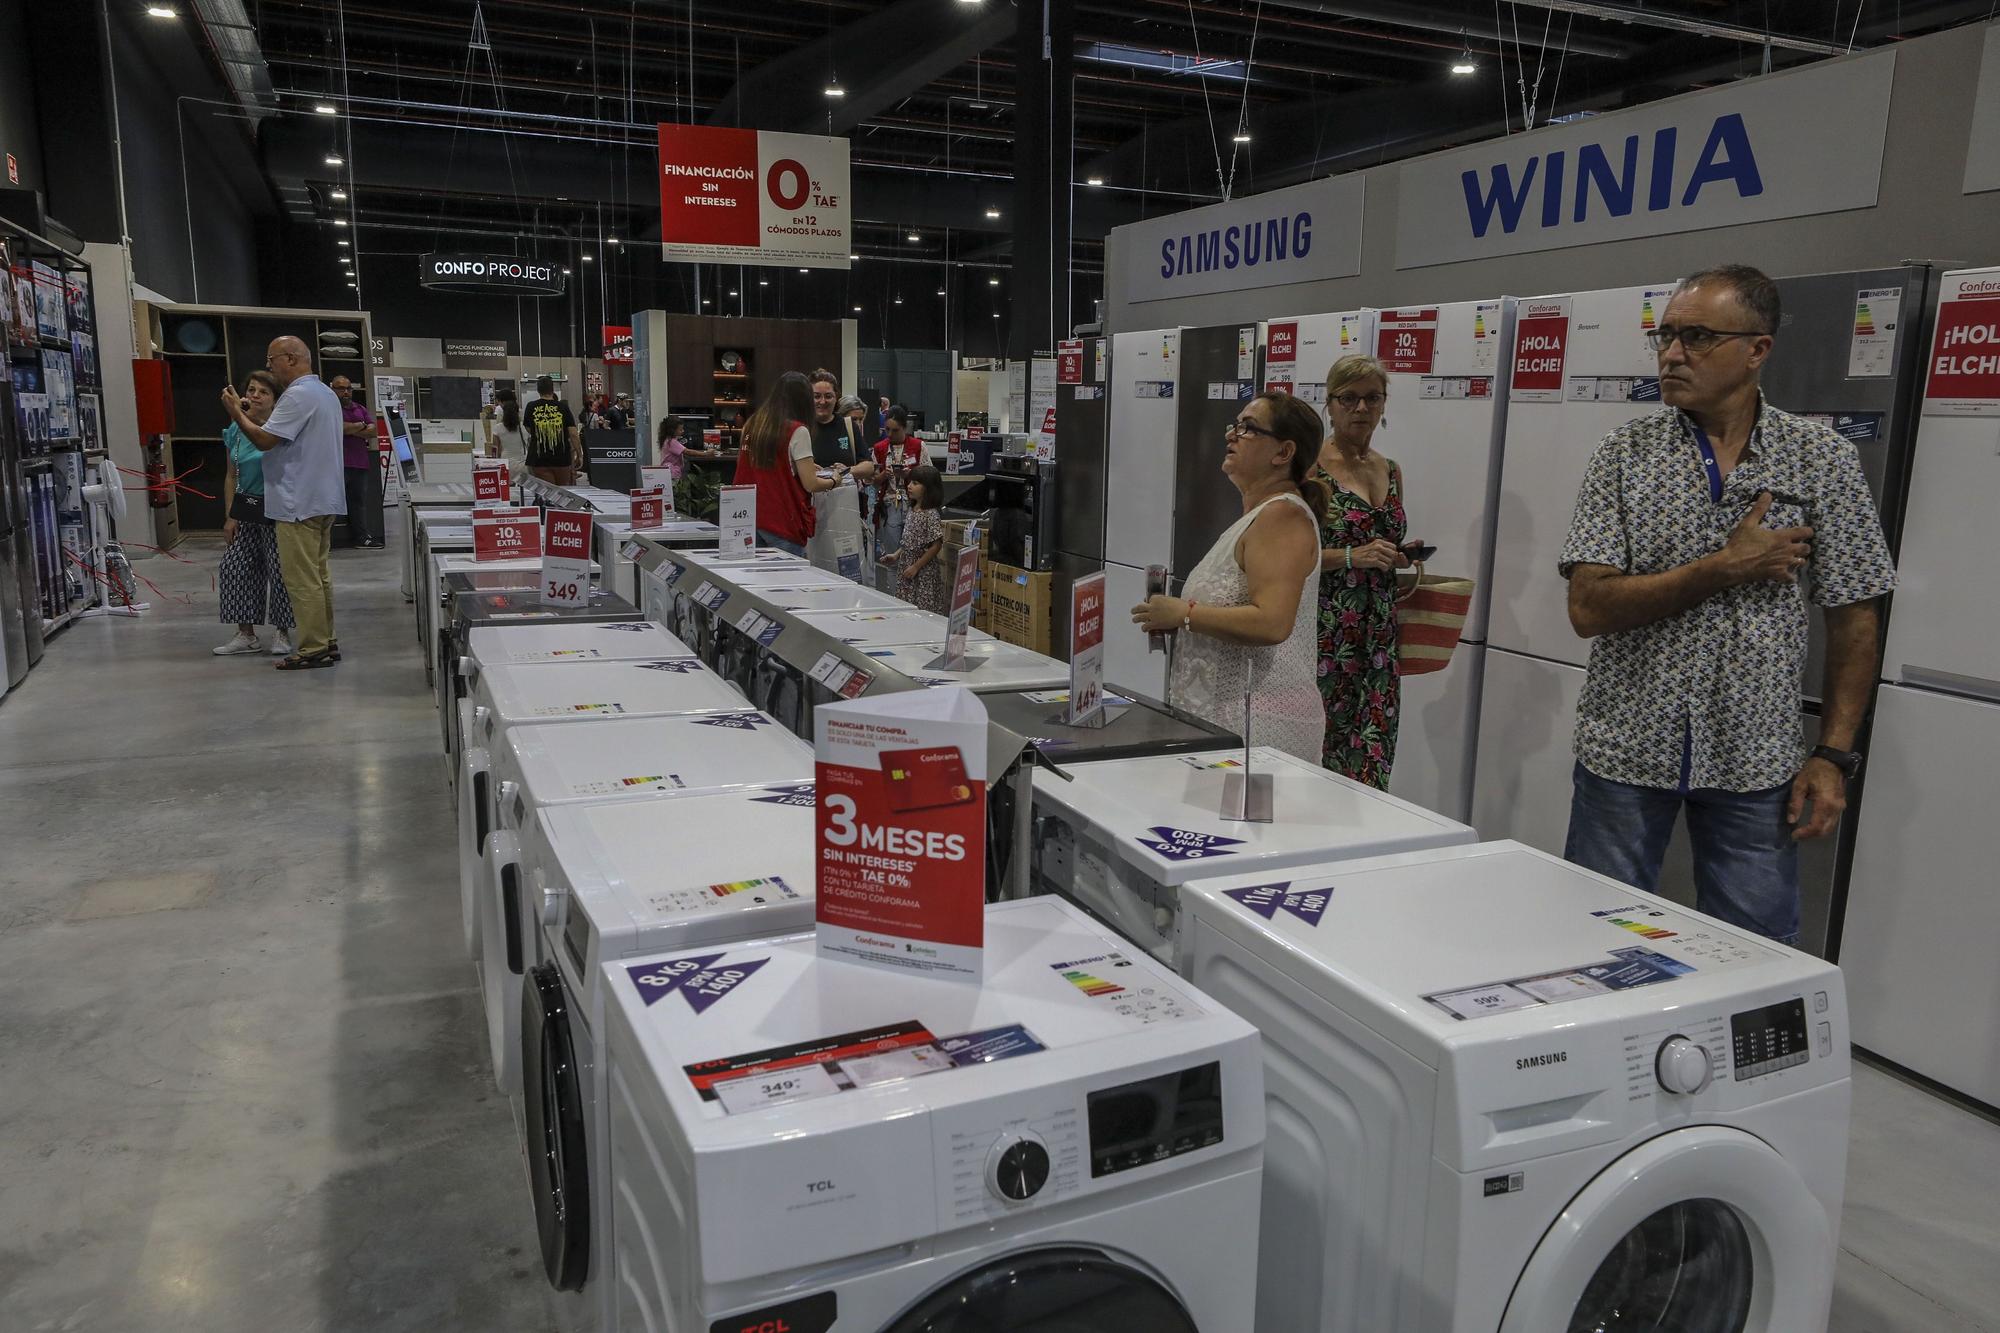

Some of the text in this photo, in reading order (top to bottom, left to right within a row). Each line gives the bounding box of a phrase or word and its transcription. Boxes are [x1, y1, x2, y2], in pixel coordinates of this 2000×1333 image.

[664, 164, 754, 180] FINANCIACIÓN
[1461, 113, 1763, 238] WINIA
[702, 183, 719, 192] SIN
[684, 196, 737, 207] INTERESES
[793, 215, 817, 225] EN 12
[767, 224, 842, 237] CÓMODOS PLAZOS
[1161, 212, 1312, 279] SAMSUNG
[434, 261, 551, 281] CONFO PROJECT
[1528, 304, 1561, 314] Conforama
[1272, 332, 1291, 343] ¡HOLA
[1521, 336, 1561, 353] ¡HOLA
[1271, 344, 1292, 354] ELCHE!
[1395, 348, 1416, 357] EXTRA
[1516, 357, 1561, 372] ELCHE!
[1935, 355, 2000, 375] ELCH
[606, 450, 633, 458] CONFO
[478, 478, 495, 486] ¡HOLA
[479, 487, 497, 495] ELCHE!
[554, 522, 581, 533] ¡HOLA
[496, 539, 523, 547] EXTRA
[552, 536, 582, 548] ELCHE!
[1080, 596, 1099, 616] ¡HOLA
[1079, 617, 1100, 637] ELCHE!
[827, 720, 907, 736] FINANCIAR TU COMPRA
[920, 753, 959, 763] Conforama
[824, 793, 966, 861] 3 MESES
[1171, 830, 1216, 843] 1200
[1175, 838, 1204, 847] RPM
[823, 848, 843, 862] SIN
[1155, 843, 1204, 858] 9 Kg
[860, 868, 885, 883] TAE
[824, 876, 885, 894] CON TU TARJETA
[823, 885, 920, 909] DE CRÉDITO CONFORAMA
[1300, 894, 1326, 912] 1400
[855, 935, 896, 949] Conforama
[638, 960, 701, 987] 8 Kg
[684, 970, 717, 988] RPM
[698, 969, 745, 995] 1400
[693, 1059, 731, 1070] TCL
[1516, 1051, 1567, 1070] SAMSUNG
[806, 1180, 836, 1193] TCL
